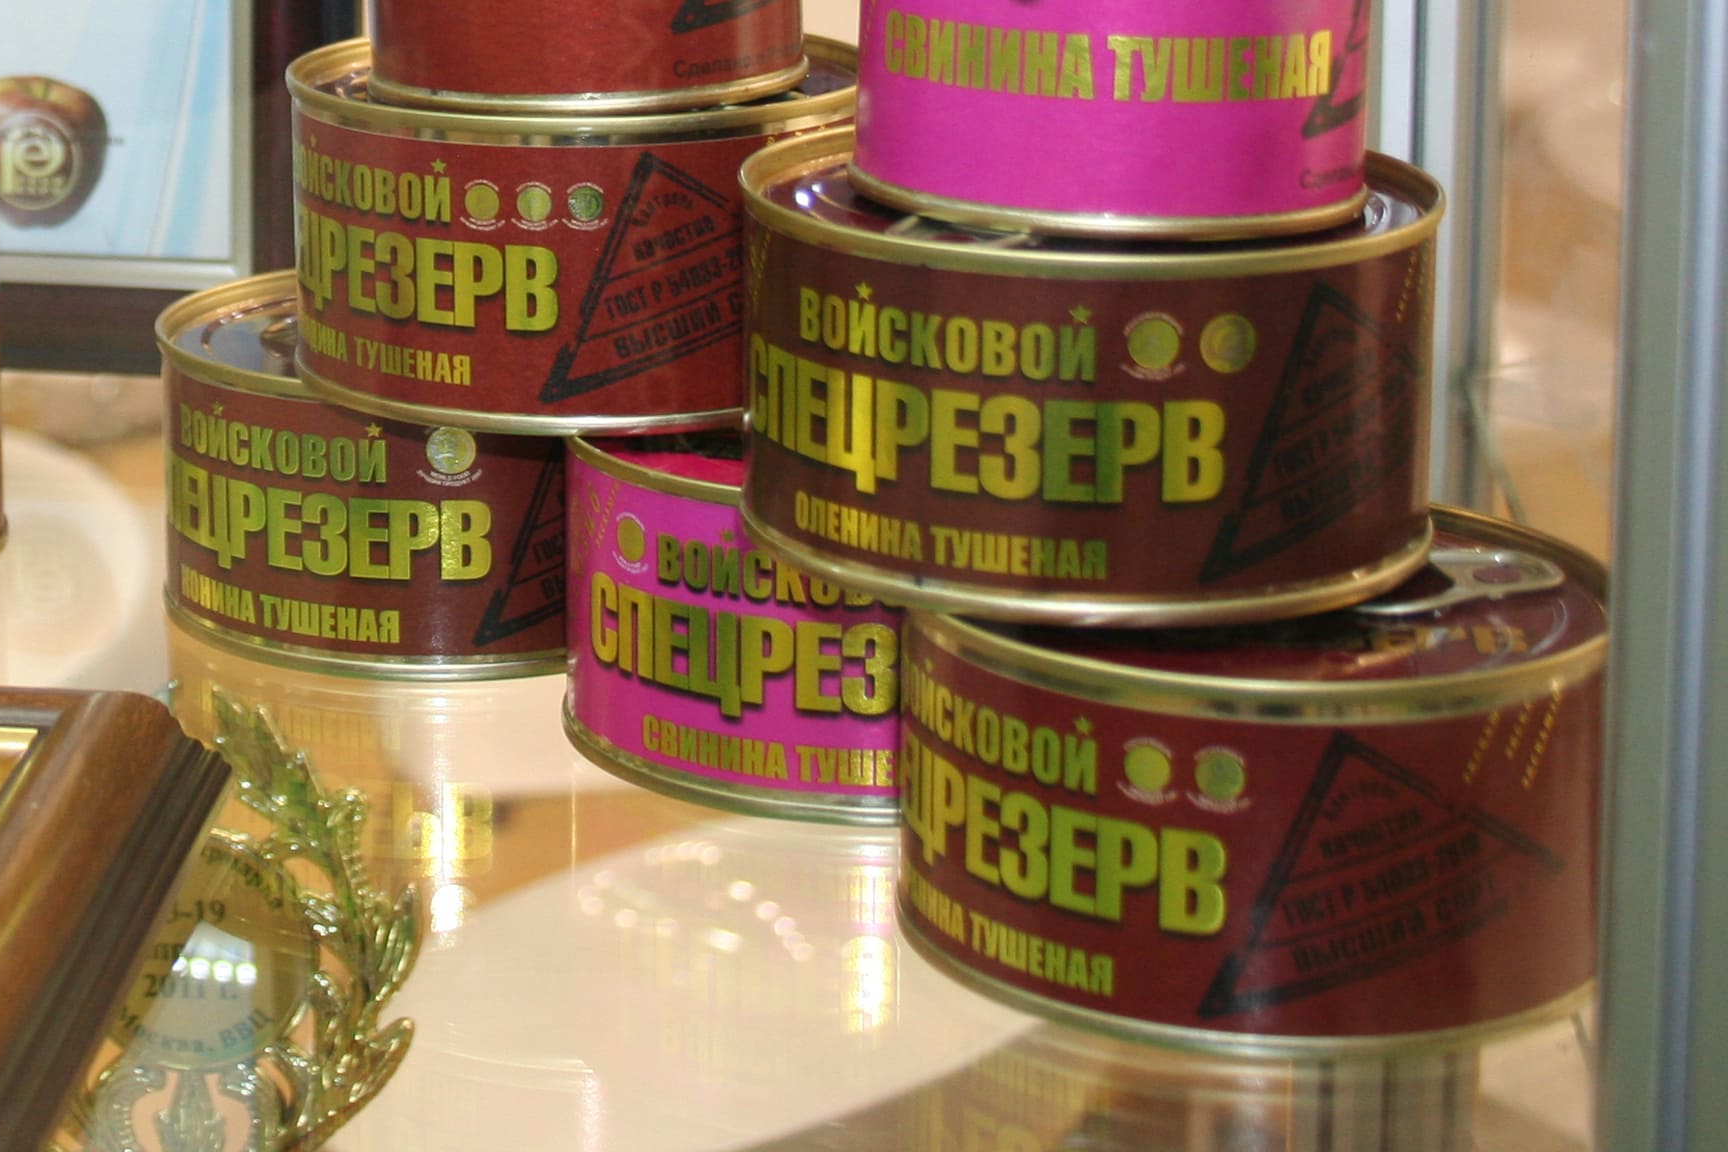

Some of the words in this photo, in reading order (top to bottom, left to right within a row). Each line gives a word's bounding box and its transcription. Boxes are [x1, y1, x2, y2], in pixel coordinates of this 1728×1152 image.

[884, 9, 1094, 101] СВИНИНА
[1107, 30, 1332, 104] ТУШЕНАЯ
[353, 336, 471, 386] ТУШЕНАЯ
[614, 300, 722, 359] ВЫСШИЙ
[799, 285, 1097, 382] ВОЙСКОВОЙ
[179, 403, 387, 483] ВОЙСКОВОЙ
[750, 333, 1225, 503] СПЕЦРЕЗЕРВ
[794, 489, 922, 559] ОЛЕНИНА
[930, 524, 1107, 580] ТУШЕНАЯ
[180, 563, 256, 625] КОНИНА
[259, 593, 400, 644] ТУШЕНАЯ
[590, 571, 899, 718] СПЕЦРЕЗ
[642, 713, 788, 780] СВИНИНА
[795, 744, 895, 787] ТУШЕ
[969, 911, 1113, 997] ТУШЕНАЯ
